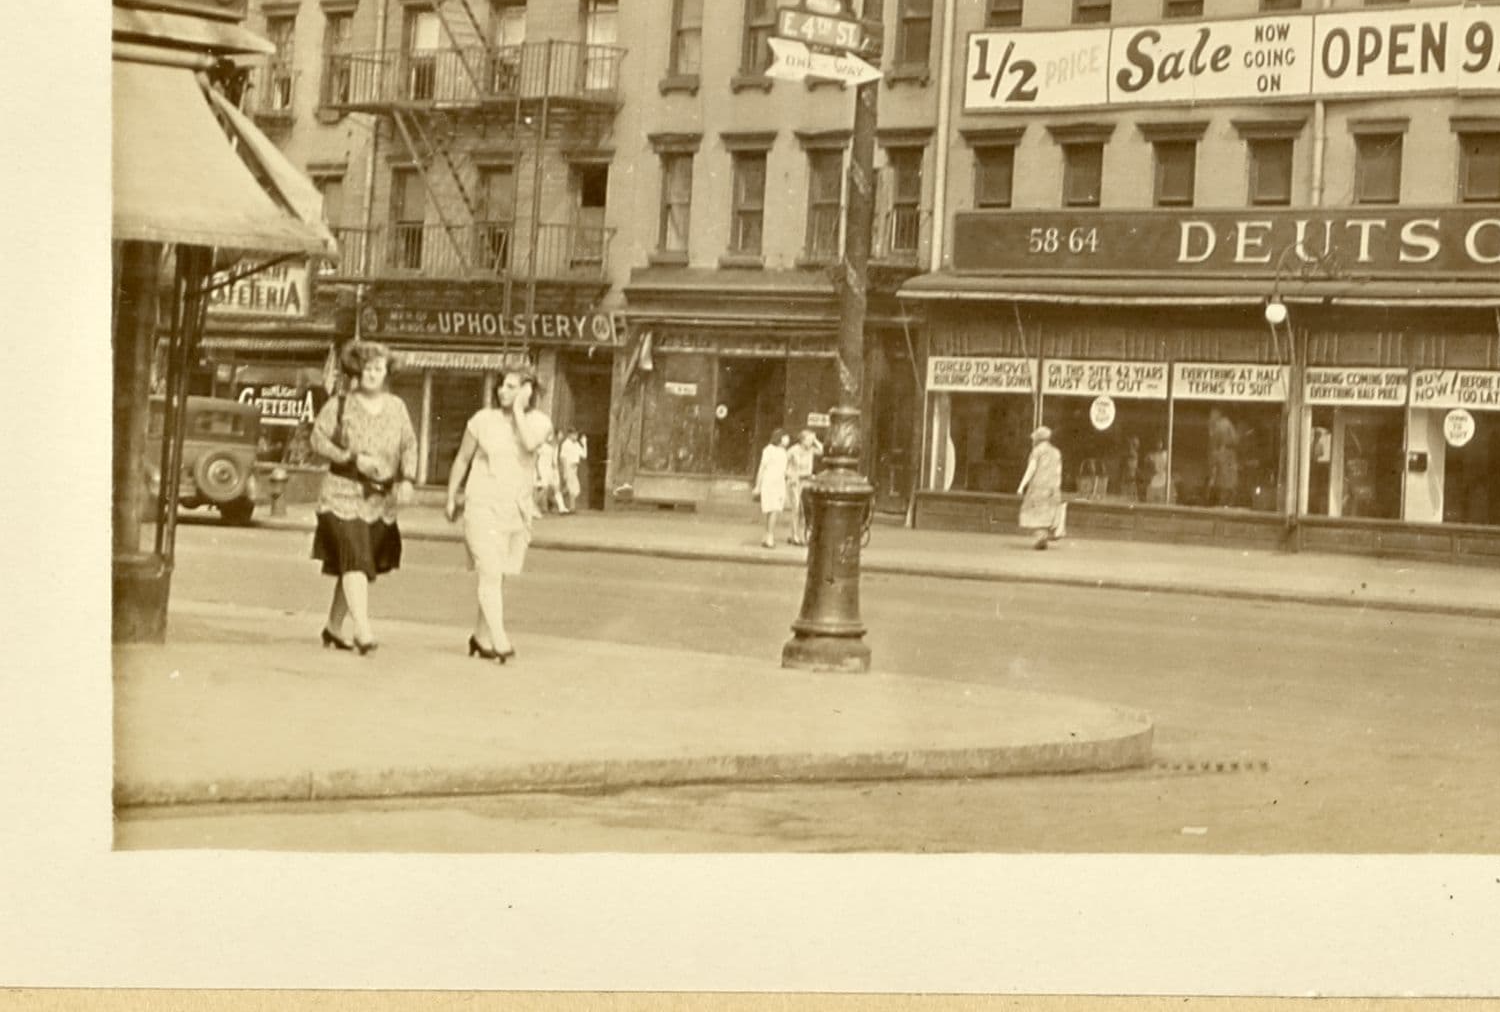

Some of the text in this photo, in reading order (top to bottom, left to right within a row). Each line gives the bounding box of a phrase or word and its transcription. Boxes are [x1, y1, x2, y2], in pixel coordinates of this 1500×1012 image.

[783, 11, 798, 37] E
[1254, 23, 1290, 42] NOW
[1244, 47, 1296, 69] GOING
[1322, 21, 1448, 79] OPEN
[970, 39, 1102, 101] 1/2 PRICE
[1116, 28, 1232, 93] Sale
[1257, 74, 1282, 93] ON
[437, 311, 586, 338] UPHOLSTERY
[934, 360, 972, 373] FORCED
[975, 362, 990, 373] TO
[1065, 364, 1085, 377] THIS
[1088, 364, 1113, 378] SITE
[1134, 367, 1163, 380] YEARS
[1238, 368, 1253, 381] AT
[1256, 369, 1281, 382] HALF
[1048, 378, 1143, 392] MUST GET OUT
[1189, 381, 1273, 396] TERMS TO SUIT
[1415, 371, 1445, 387] BUY
[1461, 375, 1491, 388] BEFORE
[1415, 382, 1449, 403] NOW
[1457, 389, 1477, 403] TOO
